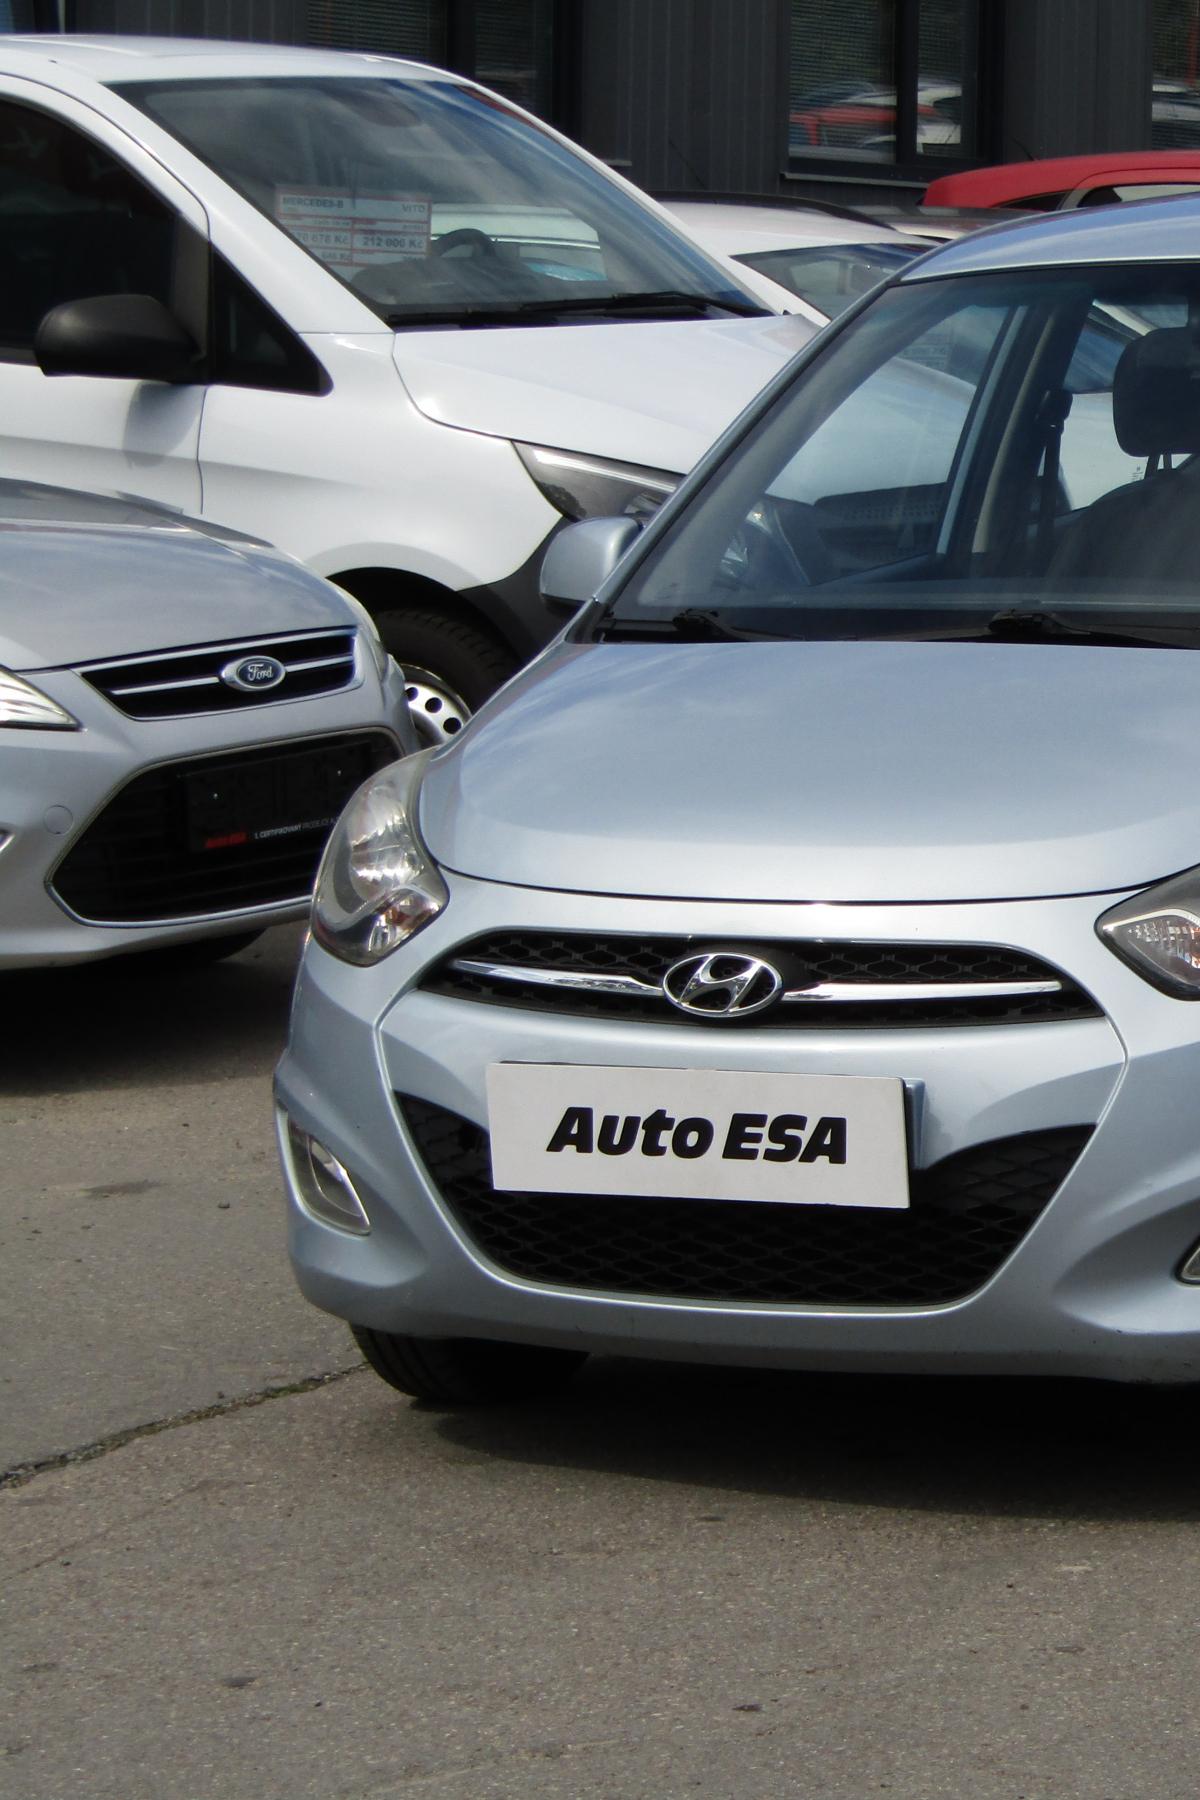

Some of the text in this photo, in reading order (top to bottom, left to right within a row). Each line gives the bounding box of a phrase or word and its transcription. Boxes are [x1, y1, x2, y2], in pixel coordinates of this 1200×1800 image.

[247, 663, 274, 682] Ford
[546, 1106, 847, 1165] Auto ESA
